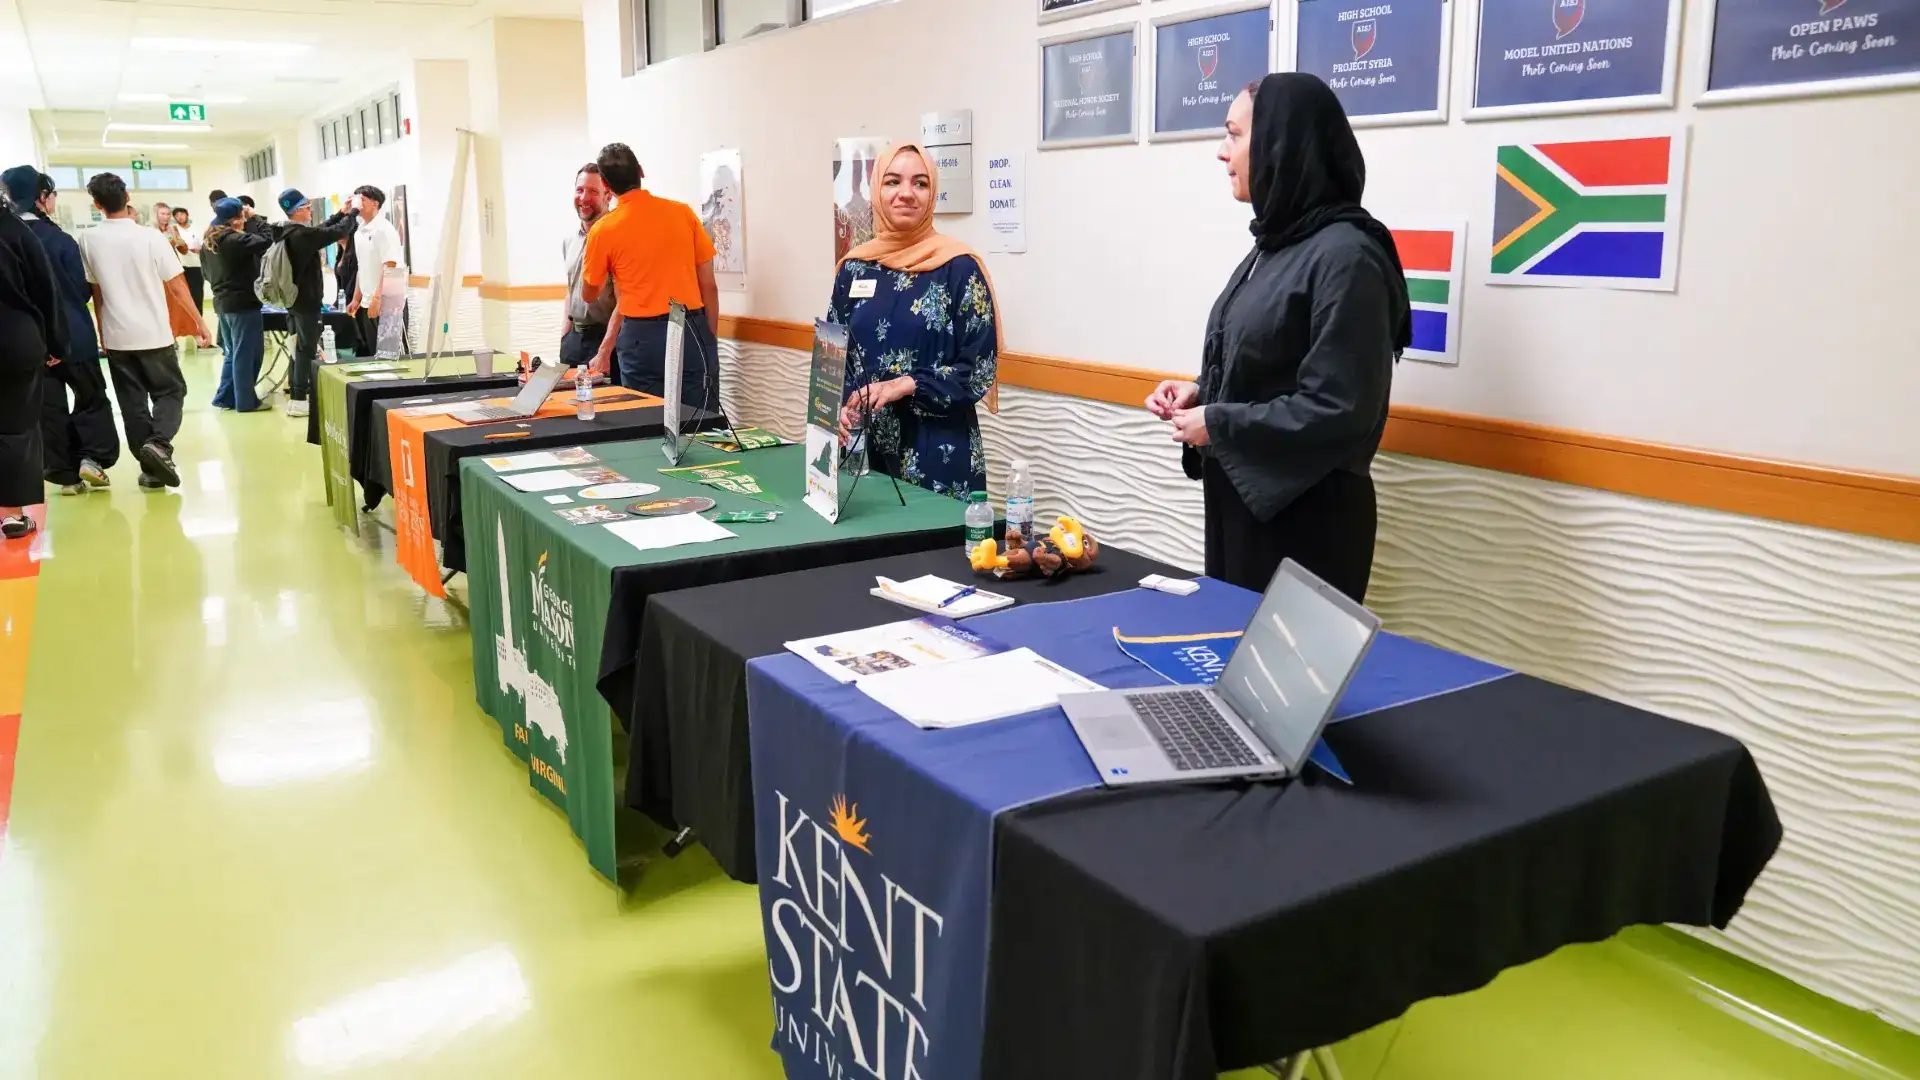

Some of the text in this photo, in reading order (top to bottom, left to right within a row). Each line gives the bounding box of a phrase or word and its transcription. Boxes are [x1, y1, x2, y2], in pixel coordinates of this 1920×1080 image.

[1338, 5, 1392, 21] HIGH SCHOOL
[1790, 13, 1878, 37] OPEN PAWS
[1187, 32, 1231, 46] HIGH SCHOOL
[1772, 34, 1897, 61] Photo Coming Soon
[1504, 37, 1633, 60] MODEL UNITED NATIONS
[1333, 58, 1393, 73] PROJECT SYRIA
[1522, 57, 1611, 76] Photo Coming Soon
[1204, 81, 1217, 90] BAC
[1330, 73, 1396, 89] Photo Coming Soon
[1183, 92, 1234, 106] Photo Coming Soon
[989, 158, 1011, 169] DROP.
[989, 179, 1012, 189] CLEAN.
[989, 198, 1017, 209] DONATE.
[543, 583, 573, 619] GEORGE
[529, 567, 576, 656] MASON
[1172, 650, 1214, 684] UNIVER
[772, 789, 944, 1012] KENT
[773, 996, 856, 1080] UNIVE
